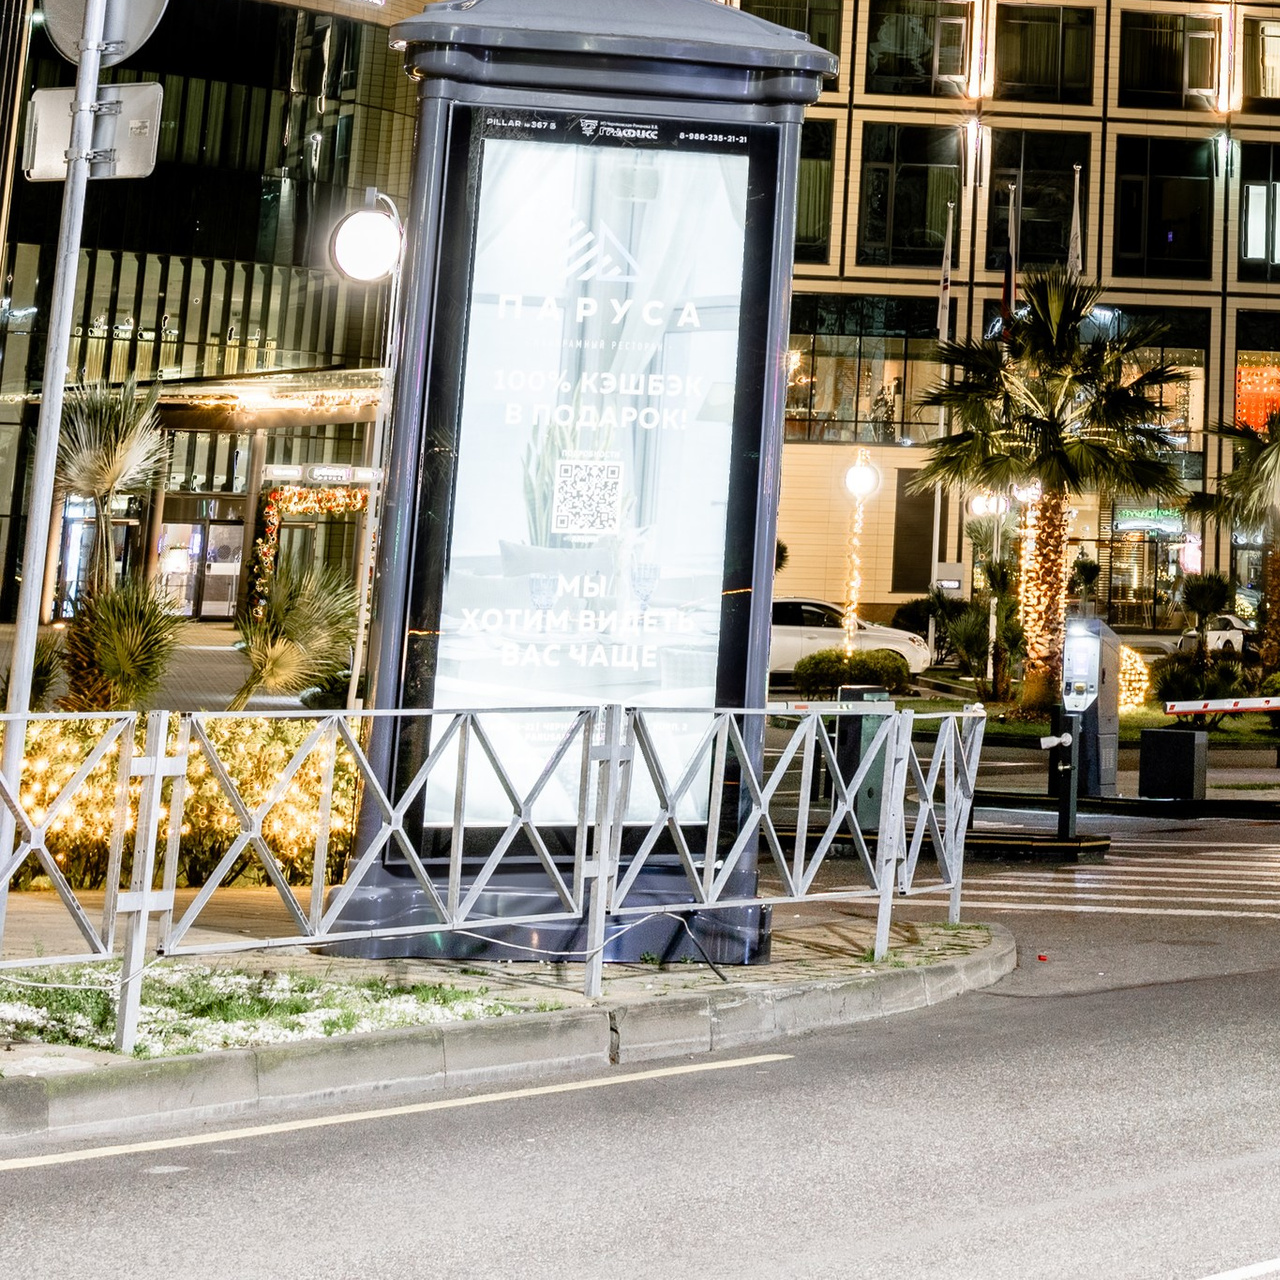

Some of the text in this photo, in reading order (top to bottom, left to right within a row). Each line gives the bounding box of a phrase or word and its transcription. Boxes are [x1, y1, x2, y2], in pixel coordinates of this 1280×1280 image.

[486, 118, 522, 128] PILLAR
[498, 293, 701, 328] ПАРУСА
[532, 338, 606, 351] РАМНЫЙ
[493, 368, 703, 397] 100% КЭШБЭК
[505, 403, 687, 431] В ПОДАРОК!
[556, 574, 607, 598] МЫ
[460, 608, 695, 636] ХОТИМ ВИДЕТЬ
[500, 642, 657, 671] ВАС ЧАЩЕ
